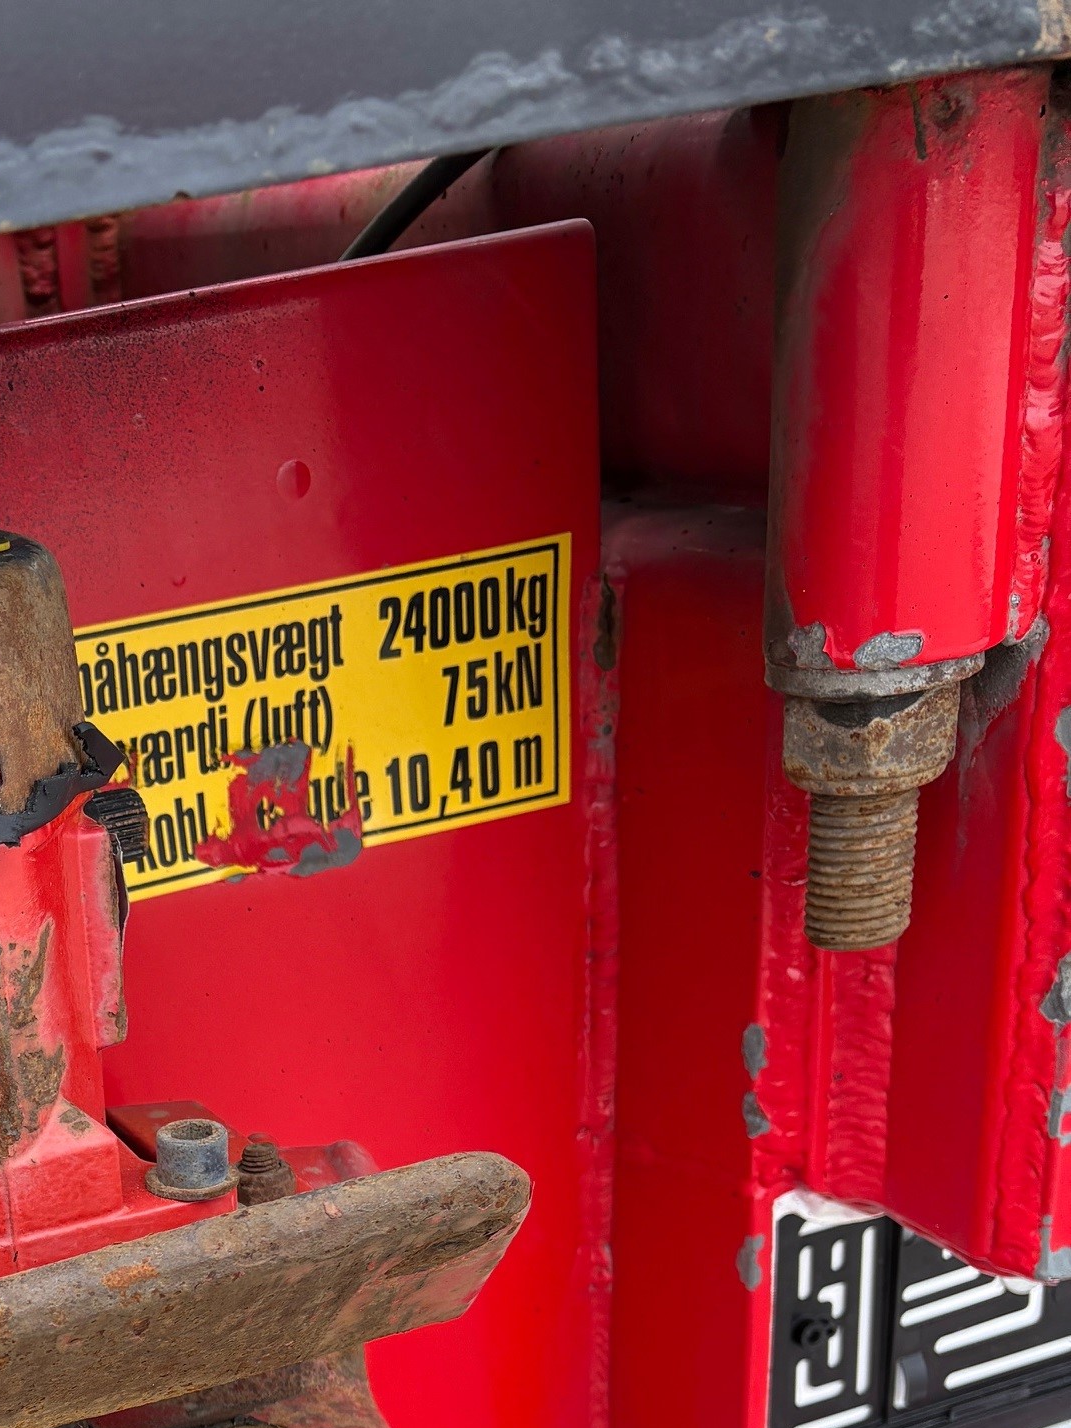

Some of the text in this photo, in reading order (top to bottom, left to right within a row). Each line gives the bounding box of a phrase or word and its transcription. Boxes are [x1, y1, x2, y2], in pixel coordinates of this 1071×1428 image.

[243, 685, 333, 755] (luft)
[385, 740, 500, 820] 10,40
[513, 733, 543, 788] m
